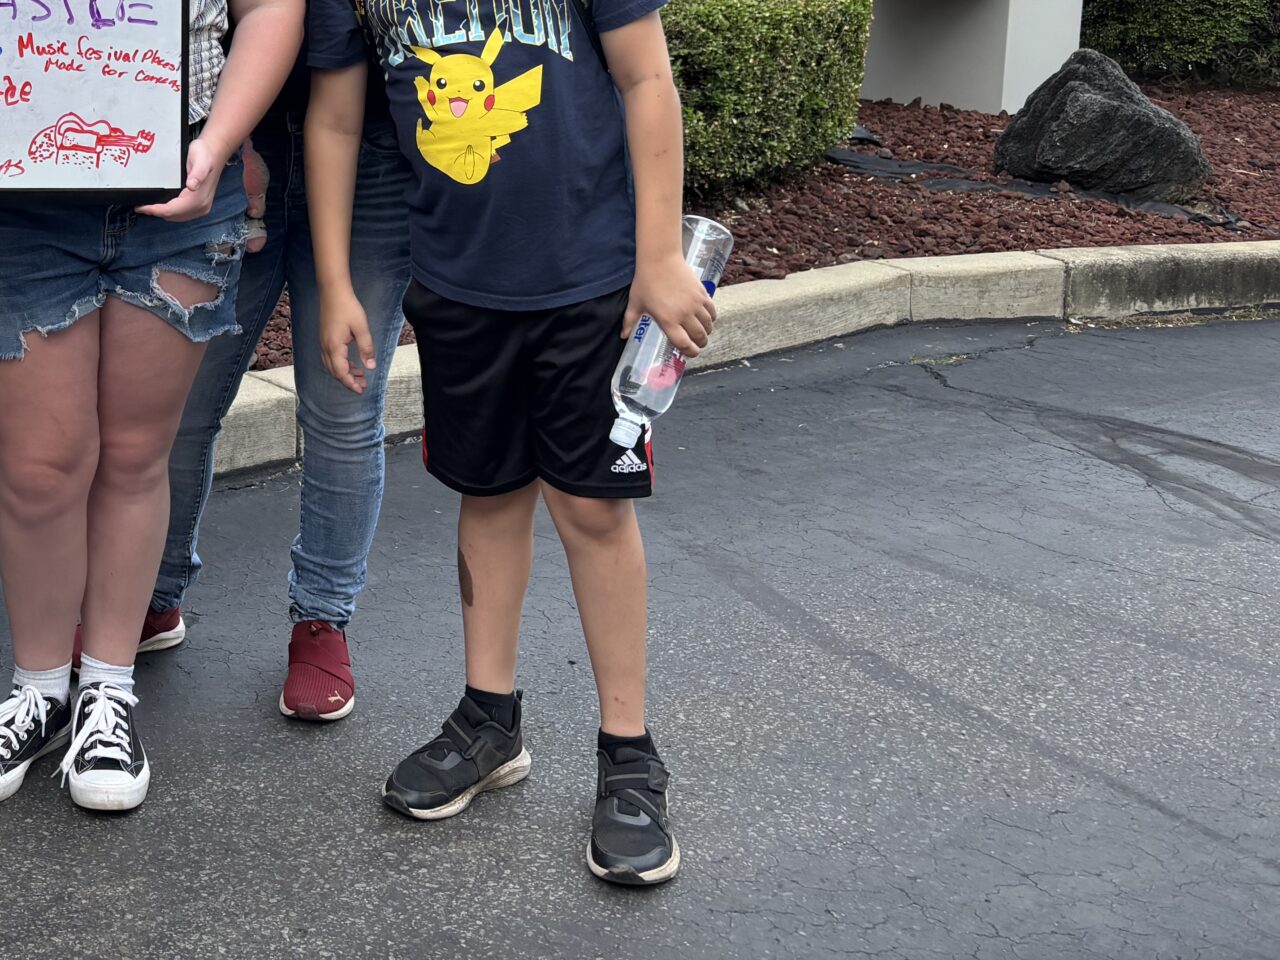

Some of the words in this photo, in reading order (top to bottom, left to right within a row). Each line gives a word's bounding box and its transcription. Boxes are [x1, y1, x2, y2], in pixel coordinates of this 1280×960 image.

[17, 32, 70, 58] Music
[633, 313, 652, 344] ater
[610, 462, 648, 474] adidas
